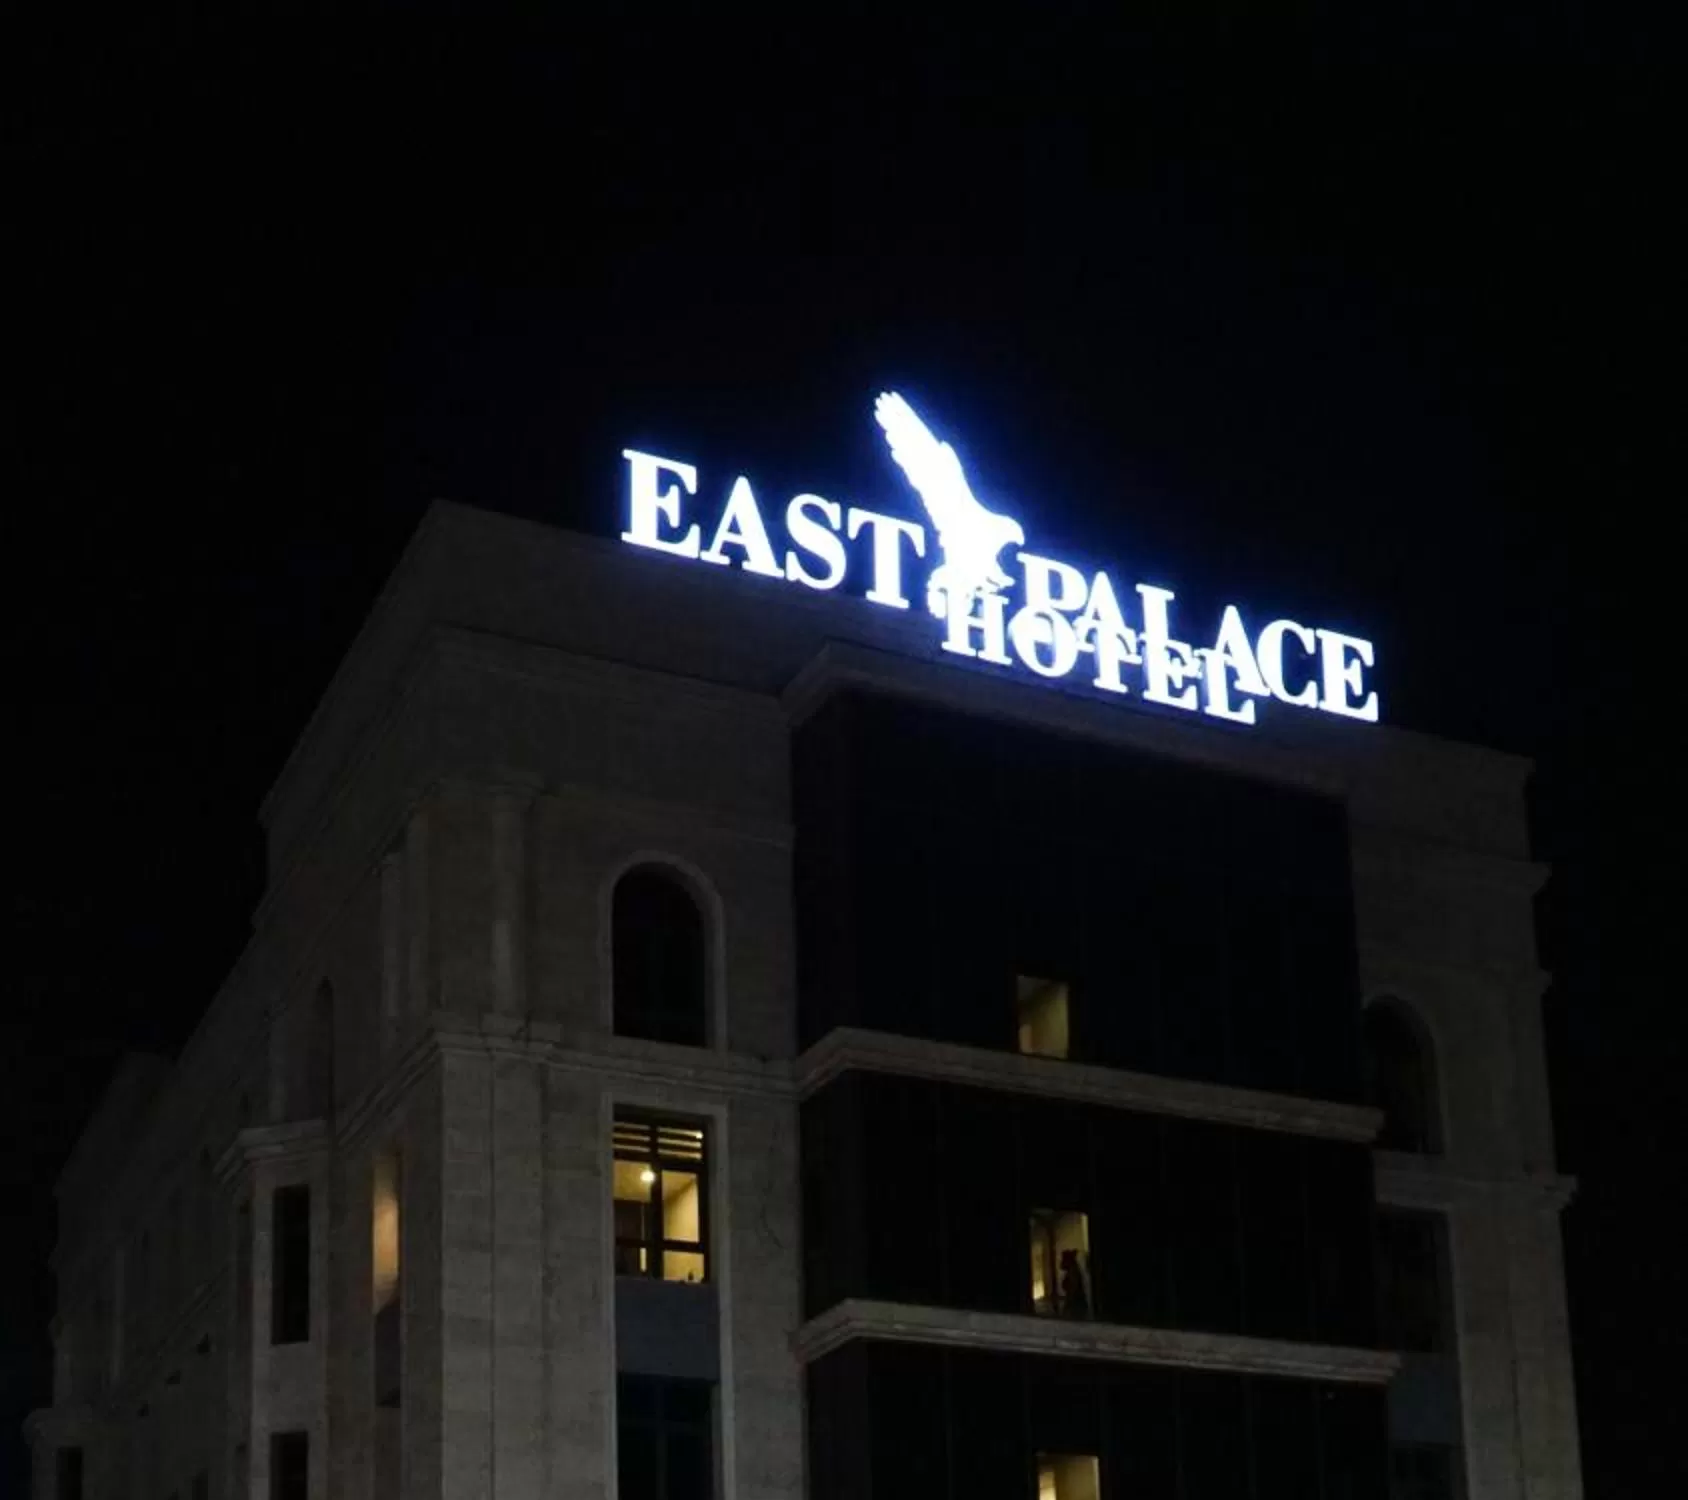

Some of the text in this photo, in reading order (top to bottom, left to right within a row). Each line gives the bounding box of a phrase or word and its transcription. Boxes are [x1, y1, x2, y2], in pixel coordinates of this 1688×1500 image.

[621, 448, 1380, 723] EAST PALACE
[940, 584, 1257, 726] HOTEL
